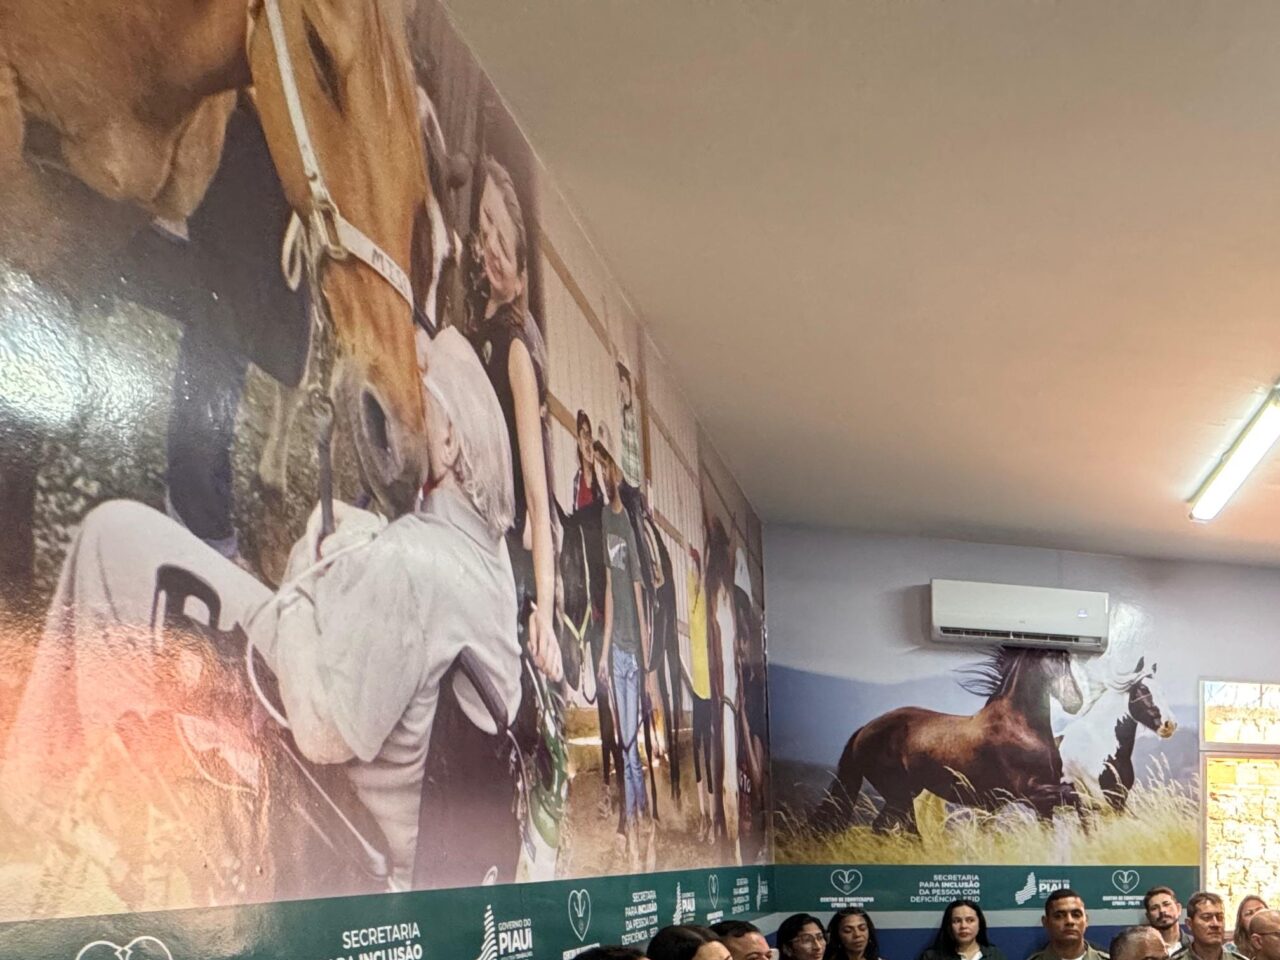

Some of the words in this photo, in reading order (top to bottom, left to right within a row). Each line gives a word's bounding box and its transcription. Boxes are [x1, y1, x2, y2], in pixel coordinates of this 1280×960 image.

[342, 922, 421, 949] SECRETARIA
[498, 920, 523, 931] GOVERNO
[523, 918, 531, 927] DO
[498, 928, 533, 955] PIAUÍ
